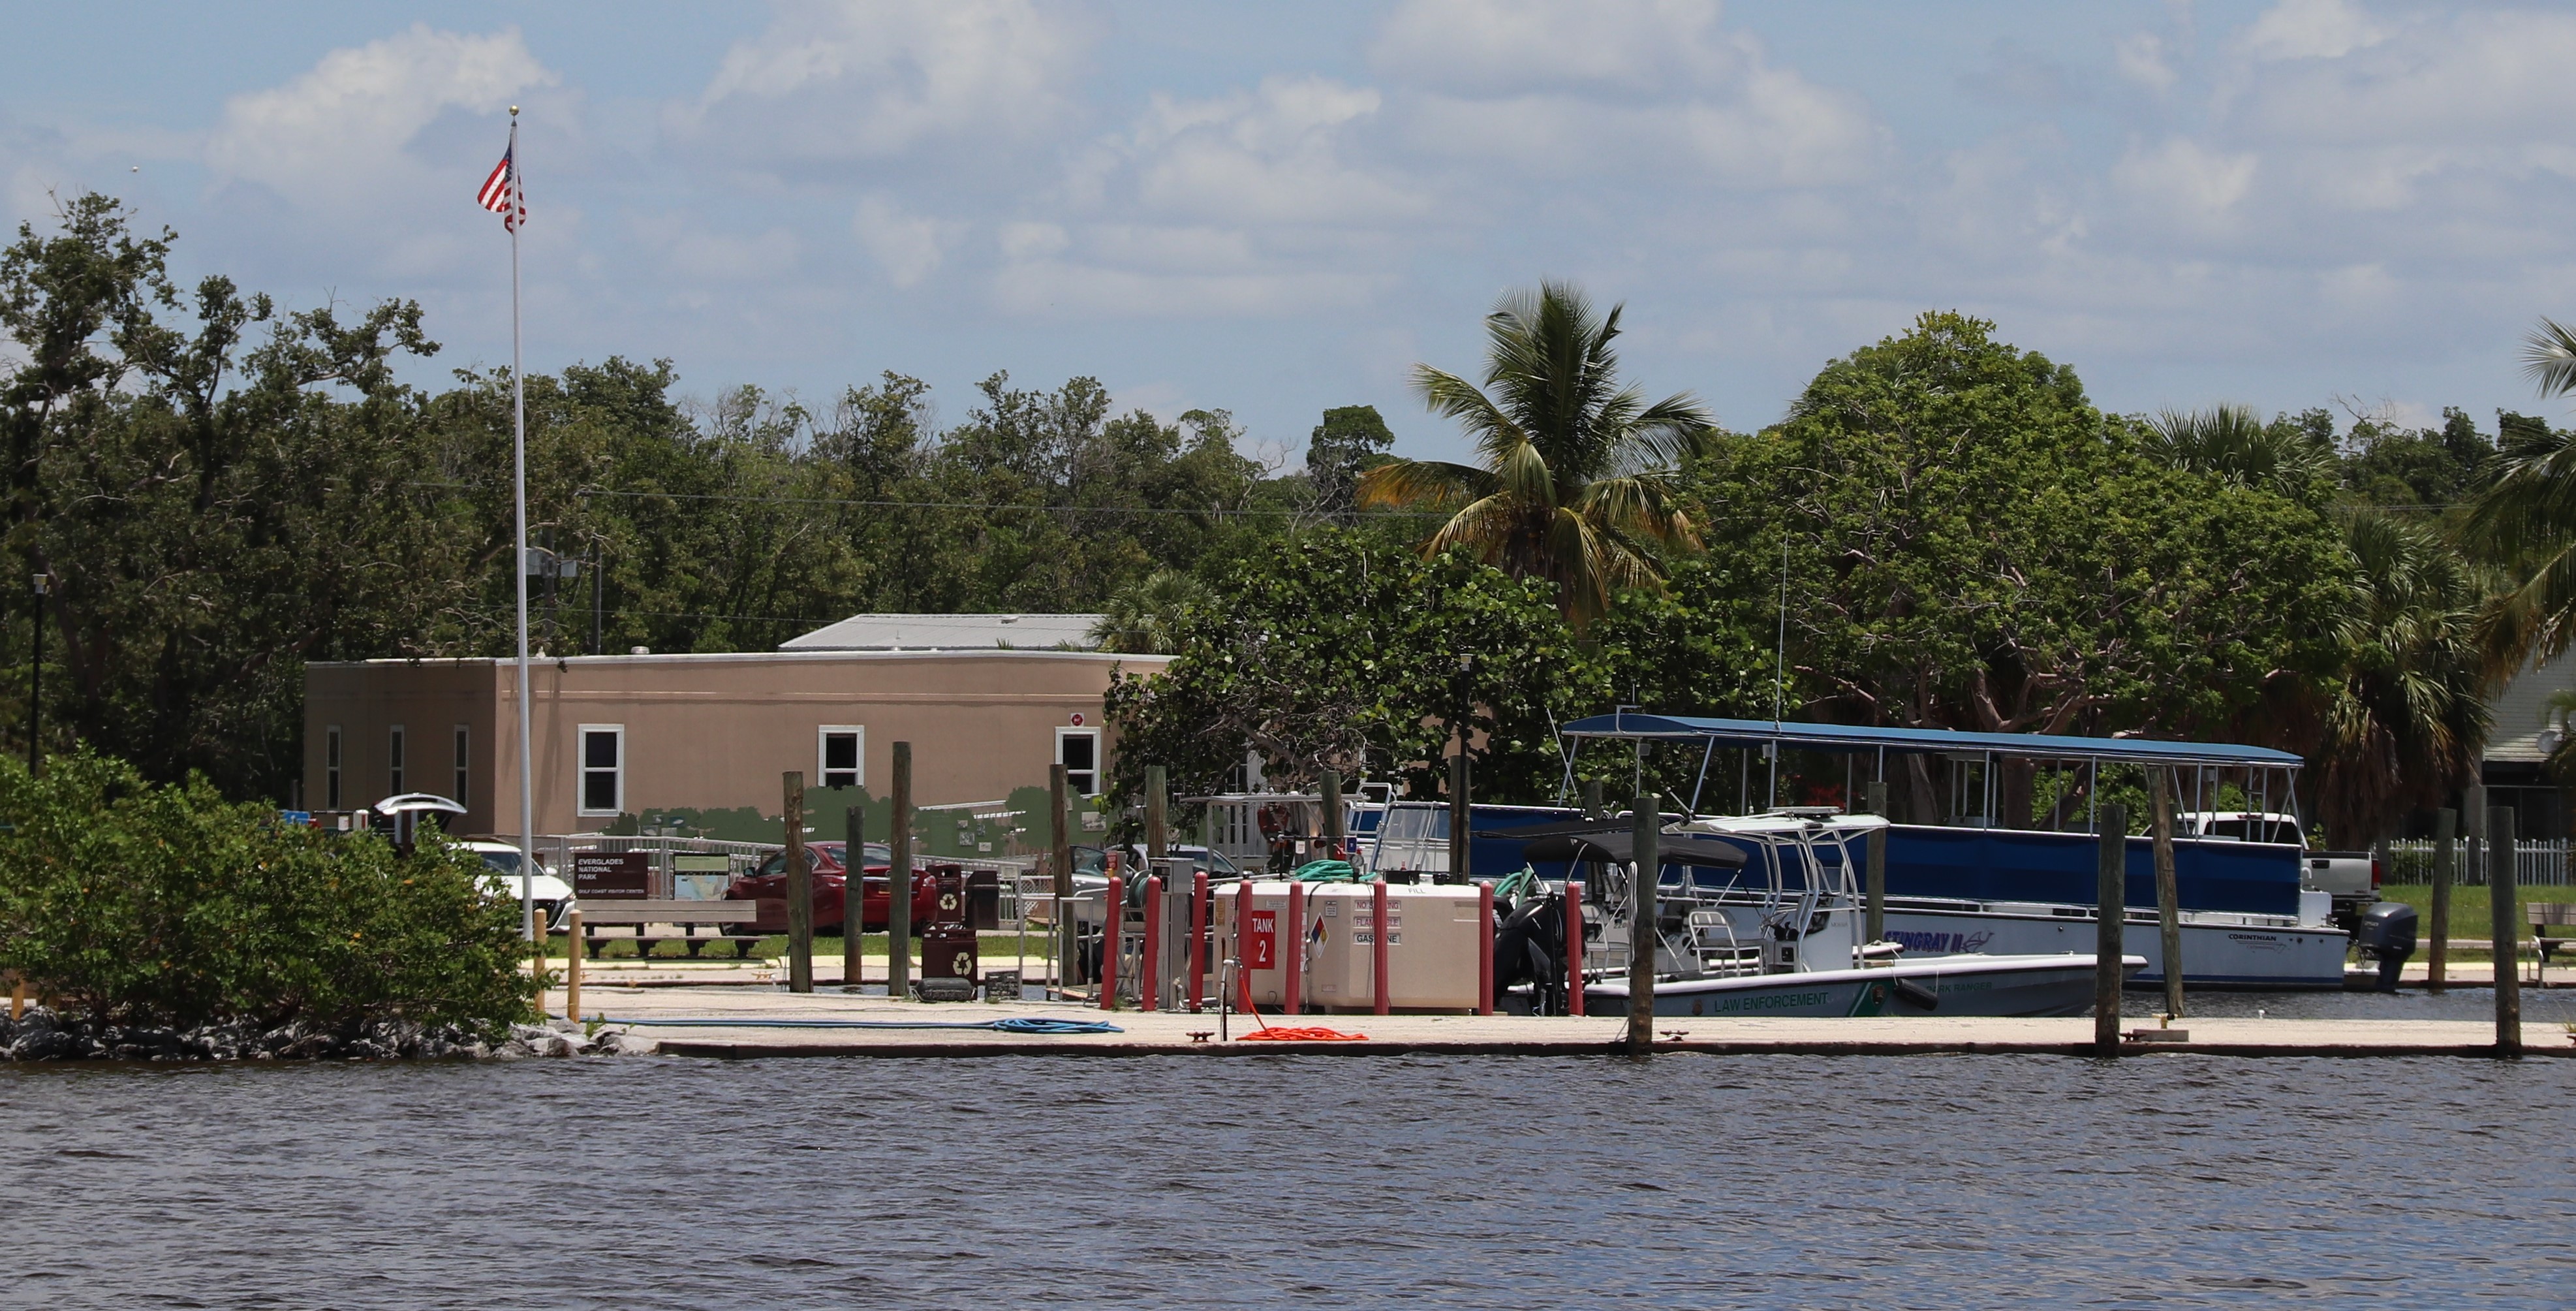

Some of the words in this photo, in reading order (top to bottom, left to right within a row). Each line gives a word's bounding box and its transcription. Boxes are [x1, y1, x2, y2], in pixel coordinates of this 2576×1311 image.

[1252, 918, 1274, 933] TANK
[1357, 934, 1397, 943] GASNE
[1884, 930, 1949, 953] STINGRAY
[1950, 933, 1964, 953] II
[1259, 940, 1267, 962] 2
[1953, 981, 1993, 992] RANGER
[1715, 998, 1741, 1013] LAW
[1743, 992, 1829, 1011] ENFORCEMENT
